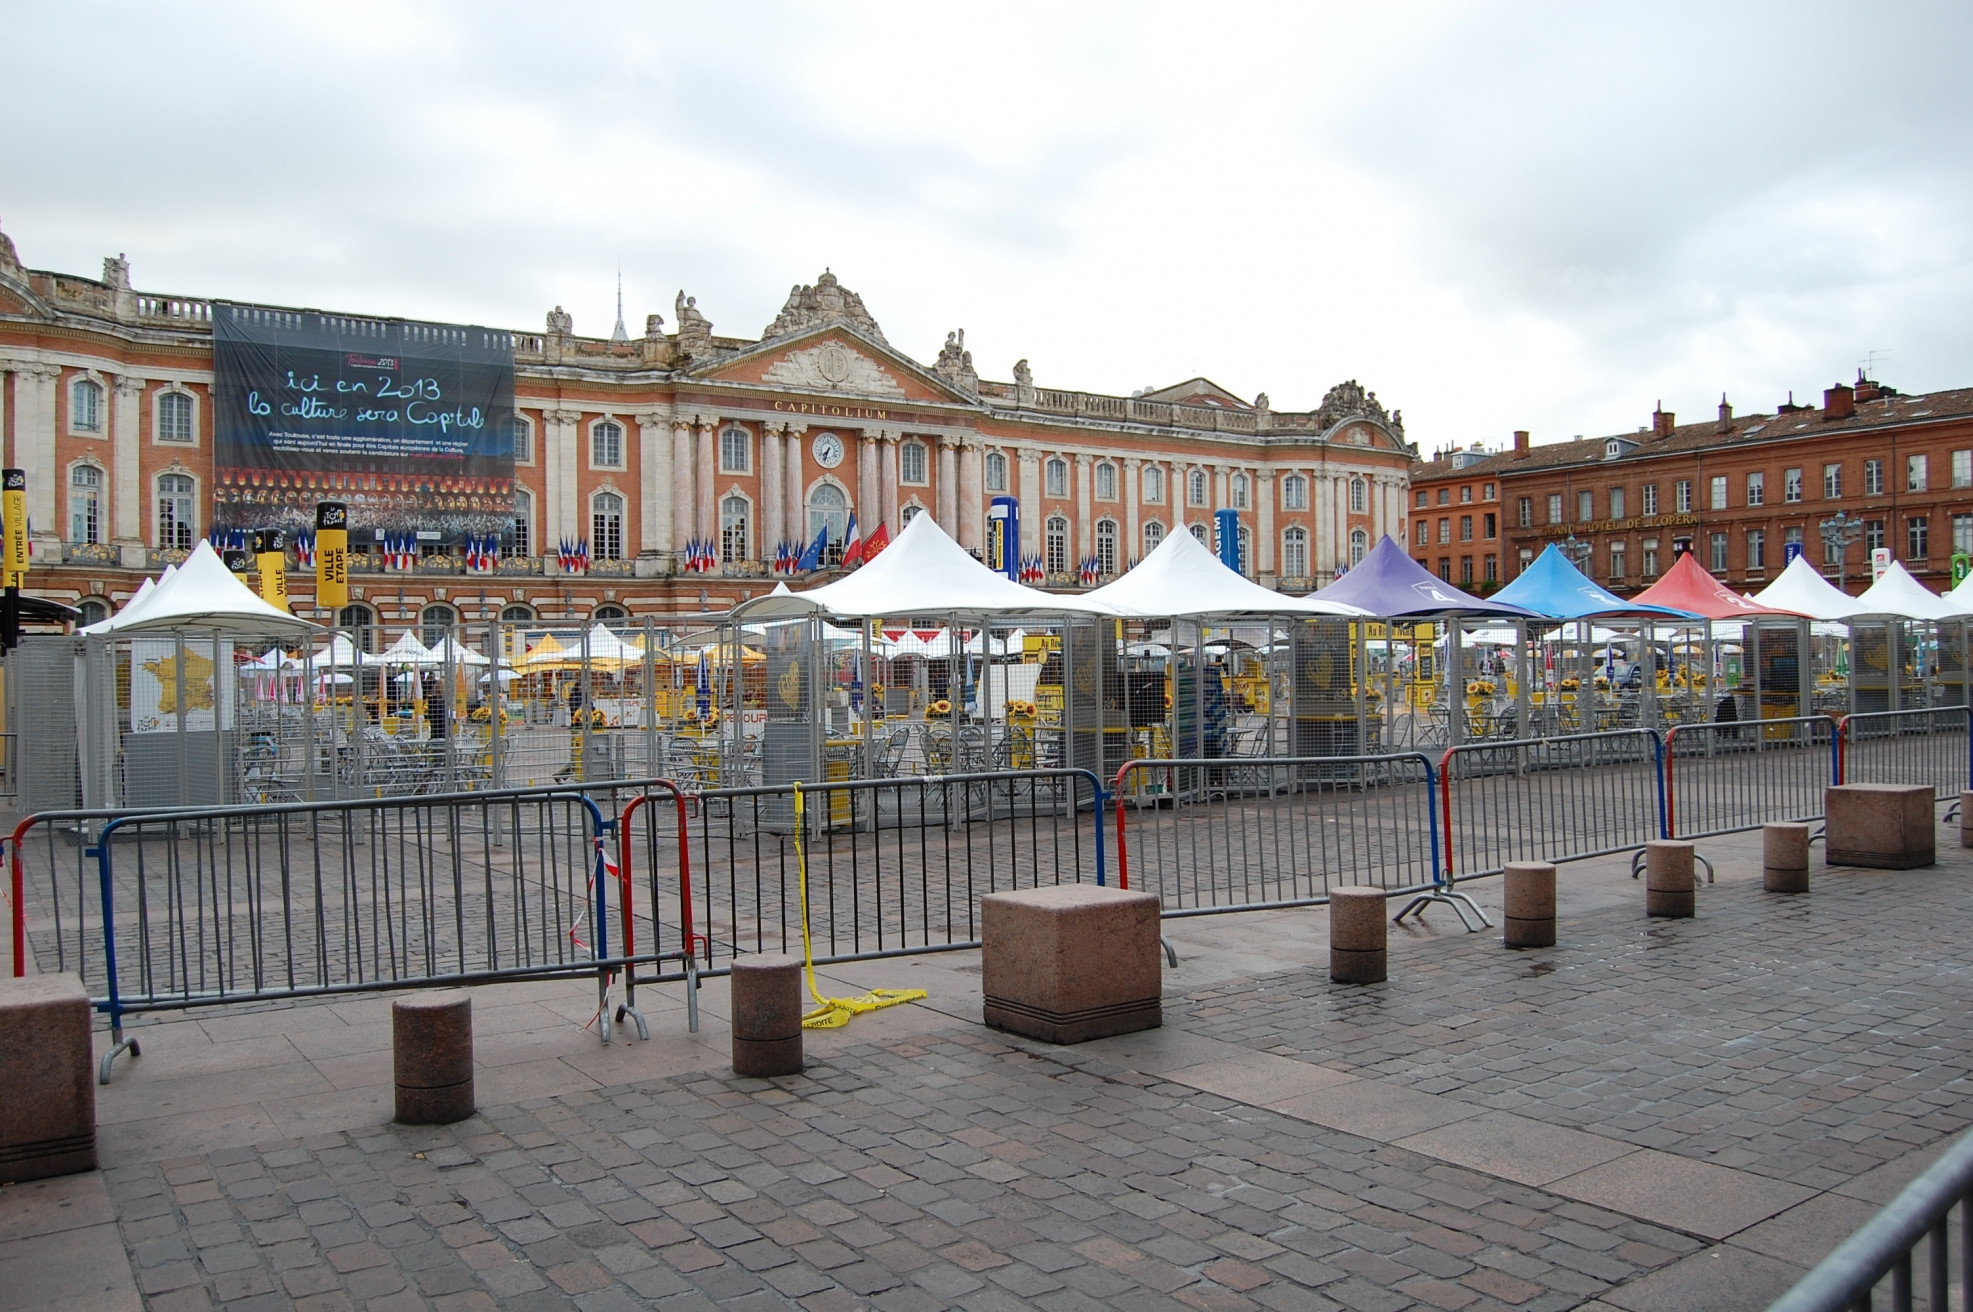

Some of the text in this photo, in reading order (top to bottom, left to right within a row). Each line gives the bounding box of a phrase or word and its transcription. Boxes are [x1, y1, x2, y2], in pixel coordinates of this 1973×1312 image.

[378, 358, 394, 366] 2013
[286, 371, 441, 400] ici en 2013
[249, 391, 485, 433] la culture sera Capitale
[774, 401, 886, 420] CAPITOLIUM
[1542, 524, 1577, 535] GRAND
[1627, 518, 1641, 529] DE
[325, 550, 334, 581] VILLE
[276, 569, 284, 596] VILLE
